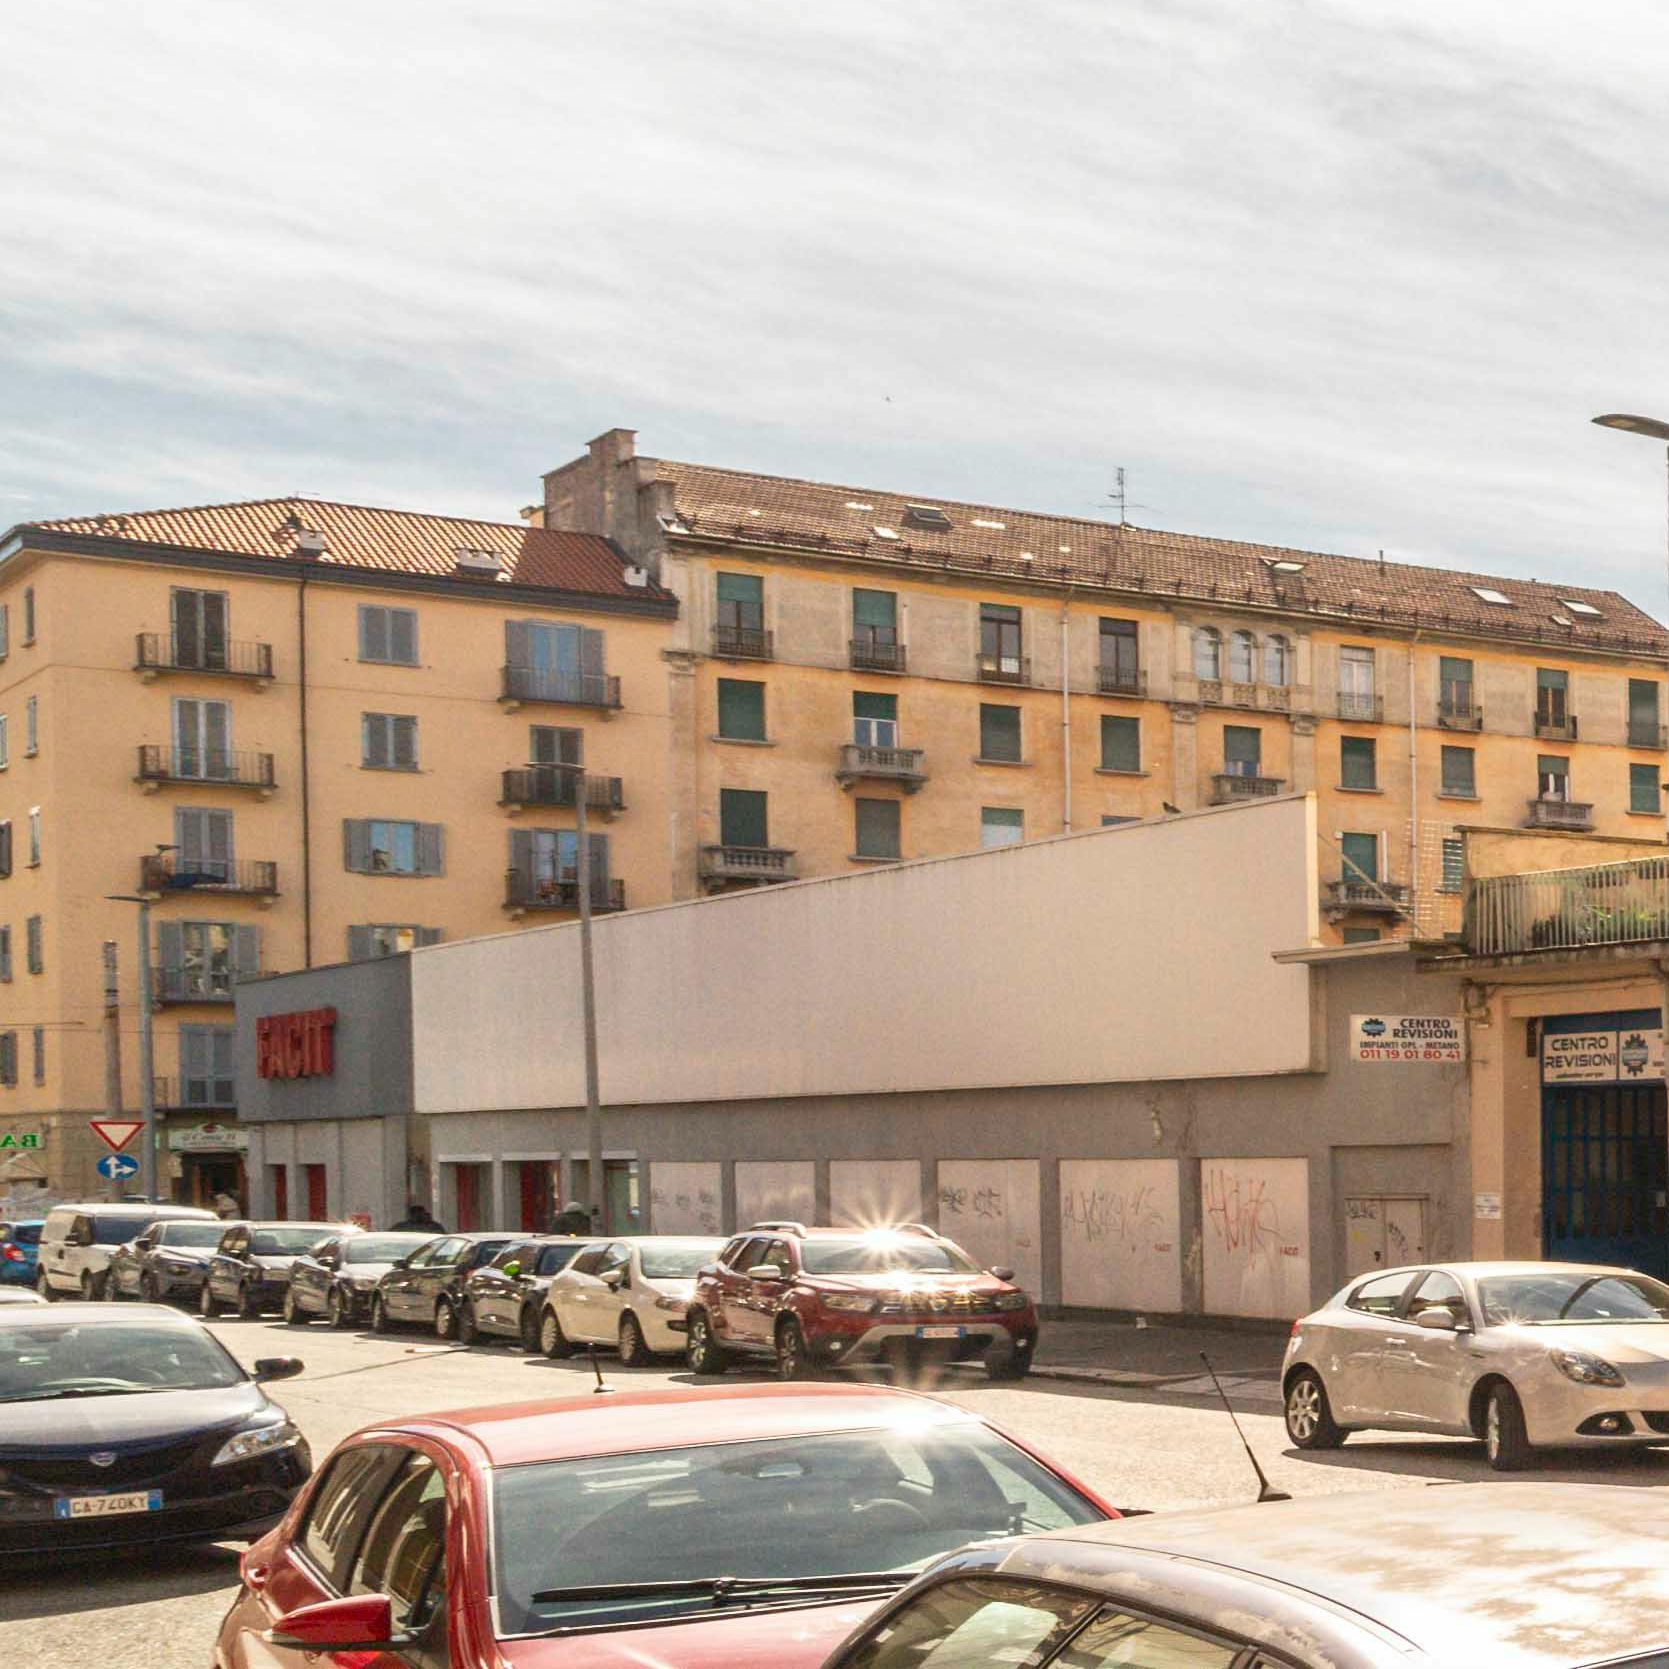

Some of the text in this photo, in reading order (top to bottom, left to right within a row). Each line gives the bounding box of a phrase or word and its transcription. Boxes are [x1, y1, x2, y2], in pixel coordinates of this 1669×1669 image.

[1400, 1018, 1451, 1028] CENTRO
[1392, 1029, 1458, 1039] REVISIONI
[1360, 1041, 1398, 1049] IMPIANTI
[1425, 1041, 1460, 1050] METANO
[1552, 1036, 1608, 1051] CENTRO
[1360, 1050, 1460, 1059] 011 19 01 80 41
[1545, 1053, 1617, 1068] REVISIONI
